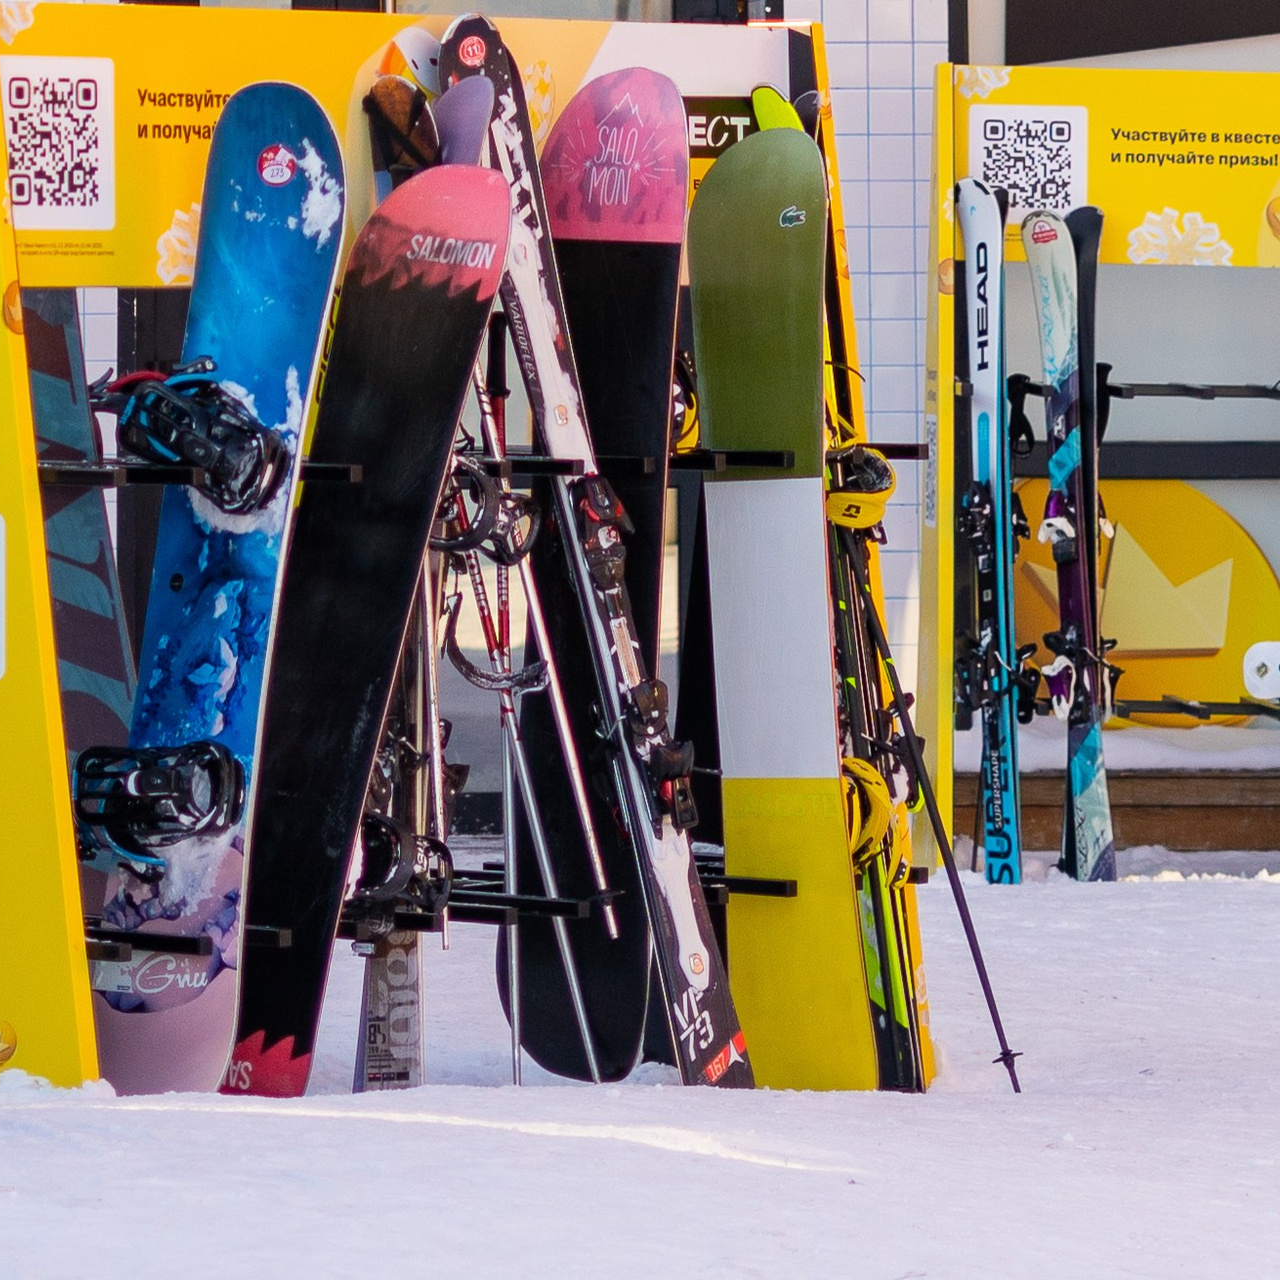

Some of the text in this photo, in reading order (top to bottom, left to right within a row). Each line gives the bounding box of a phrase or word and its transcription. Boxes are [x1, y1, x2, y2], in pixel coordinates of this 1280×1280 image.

[137, 121, 217, 144] и получа
[593, 125, 639, 166] SALO
[1111, 127, 1280, 145] Участвуйте в квесте
[1111, 151, 1279, 168] и получайте призы!
[588, 166, 632, 207] MON
[406, 233, 498, 270] SALOMON
[976, 241, 989, 372] HEAD
[990, 749, 1002, 830] SUPERSHAPE
[135, 954, 209, 994] Gnu
